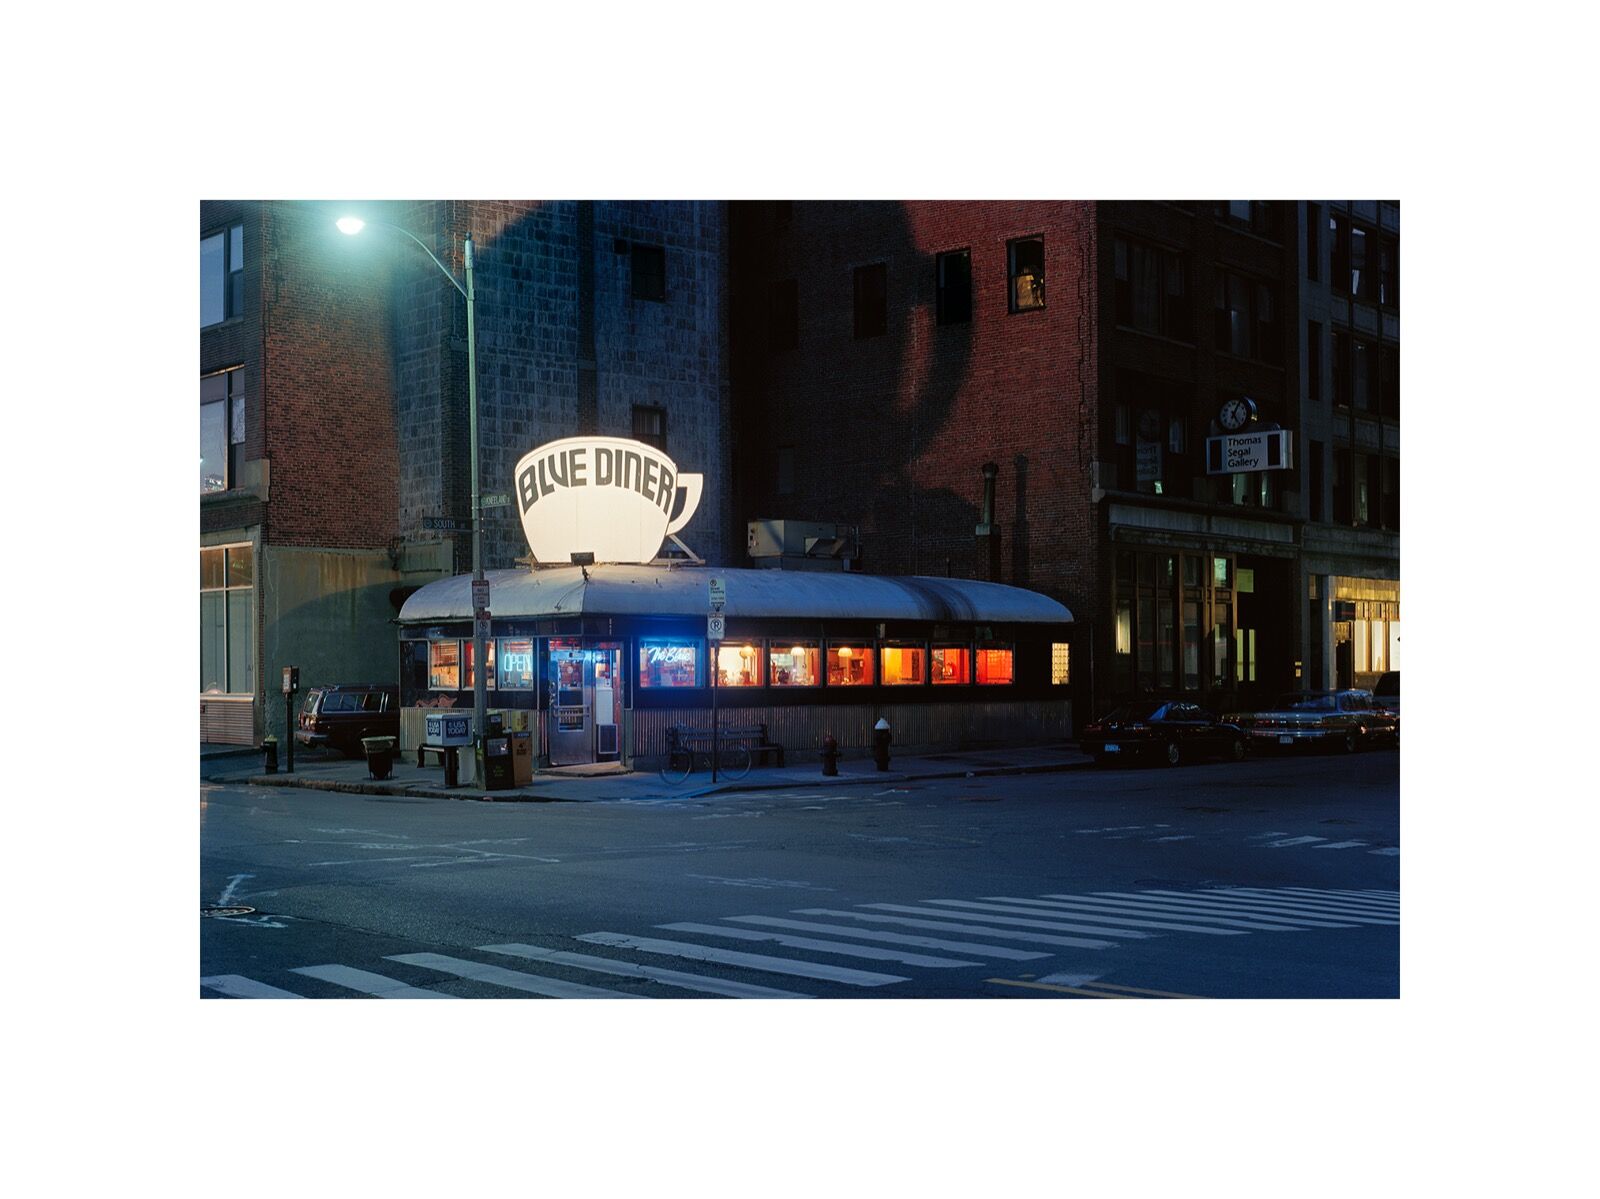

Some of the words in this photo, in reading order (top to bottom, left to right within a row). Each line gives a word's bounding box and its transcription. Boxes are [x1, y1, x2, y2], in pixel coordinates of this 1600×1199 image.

[1228, 437, 1262, 447] Thomas
[1228, 447, 1251, 458] Segal
[1228, 458, 1260, 468] Gallery
[519, 448, 587, 515] BLUE
[595, 448, 674, 516] DINER
[434, 519, 456, 528] SOUTH
[504, 653, 533, 672] OPEN
[454, 720, 465, 728] USA
[448, 727, 466, 736] TODAY
